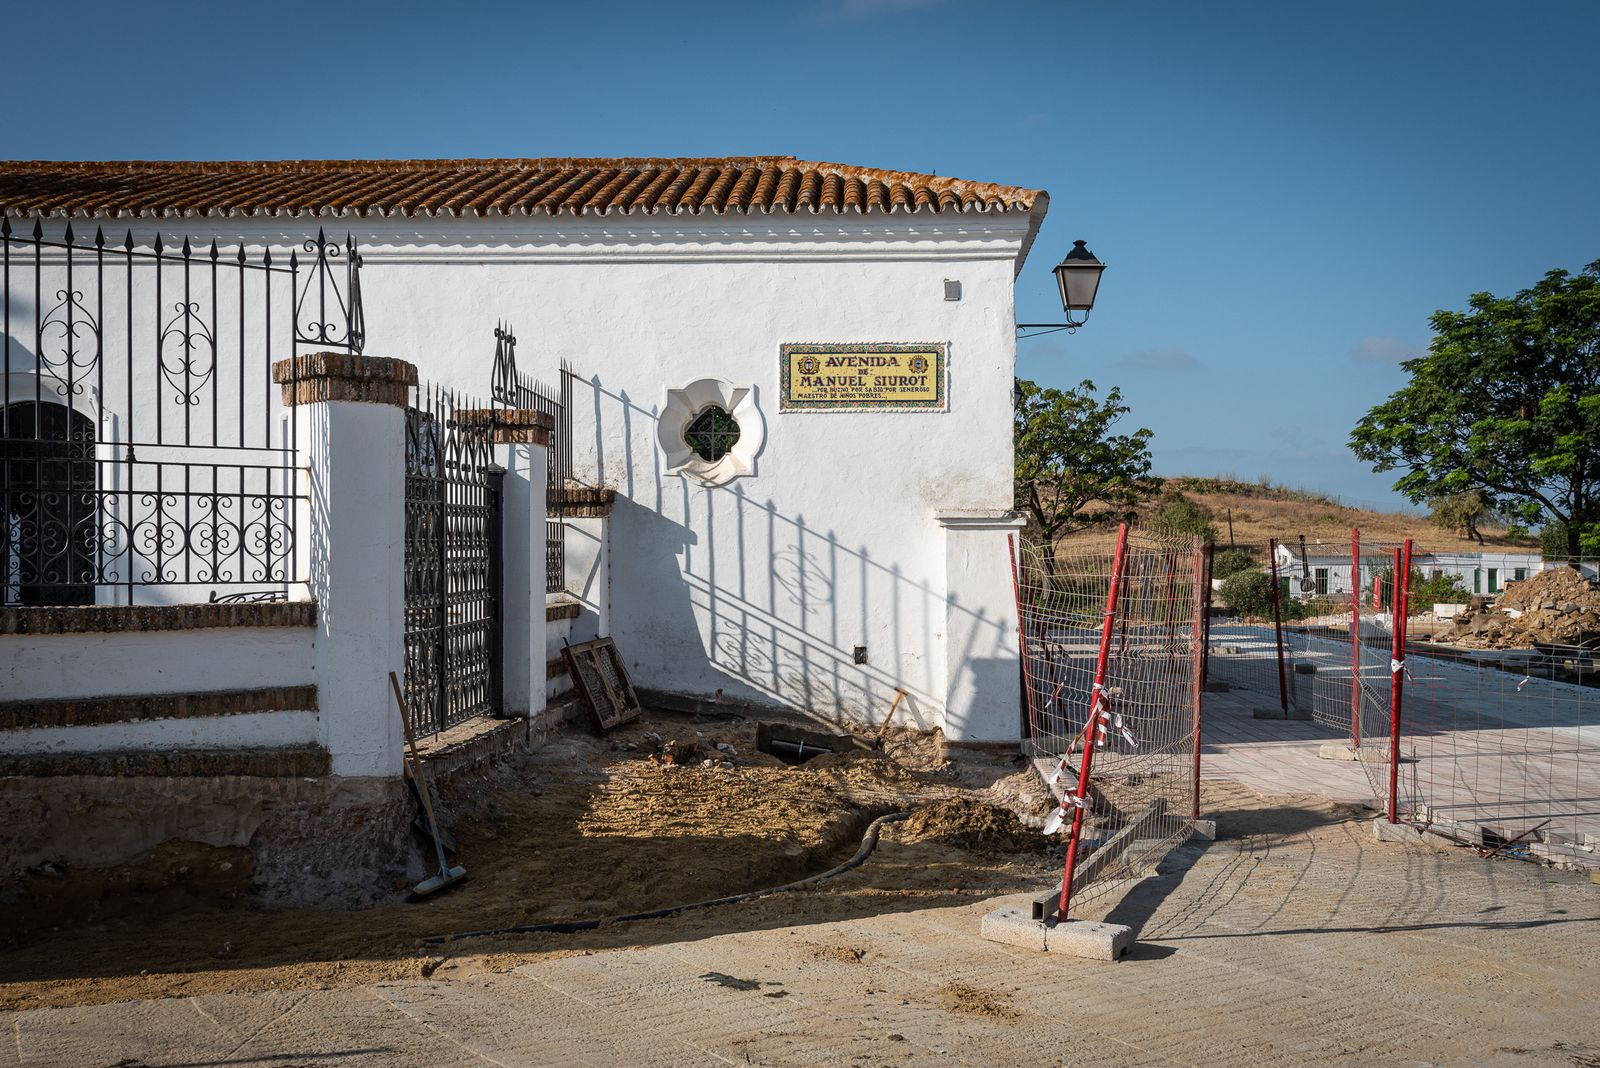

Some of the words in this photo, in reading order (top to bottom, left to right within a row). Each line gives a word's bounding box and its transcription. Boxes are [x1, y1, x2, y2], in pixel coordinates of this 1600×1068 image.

[825, 356, 900, 367] AVENIDA
[800, 376, 866, 386] MANUEL
[874, 376, 927, 386] SIUROT
